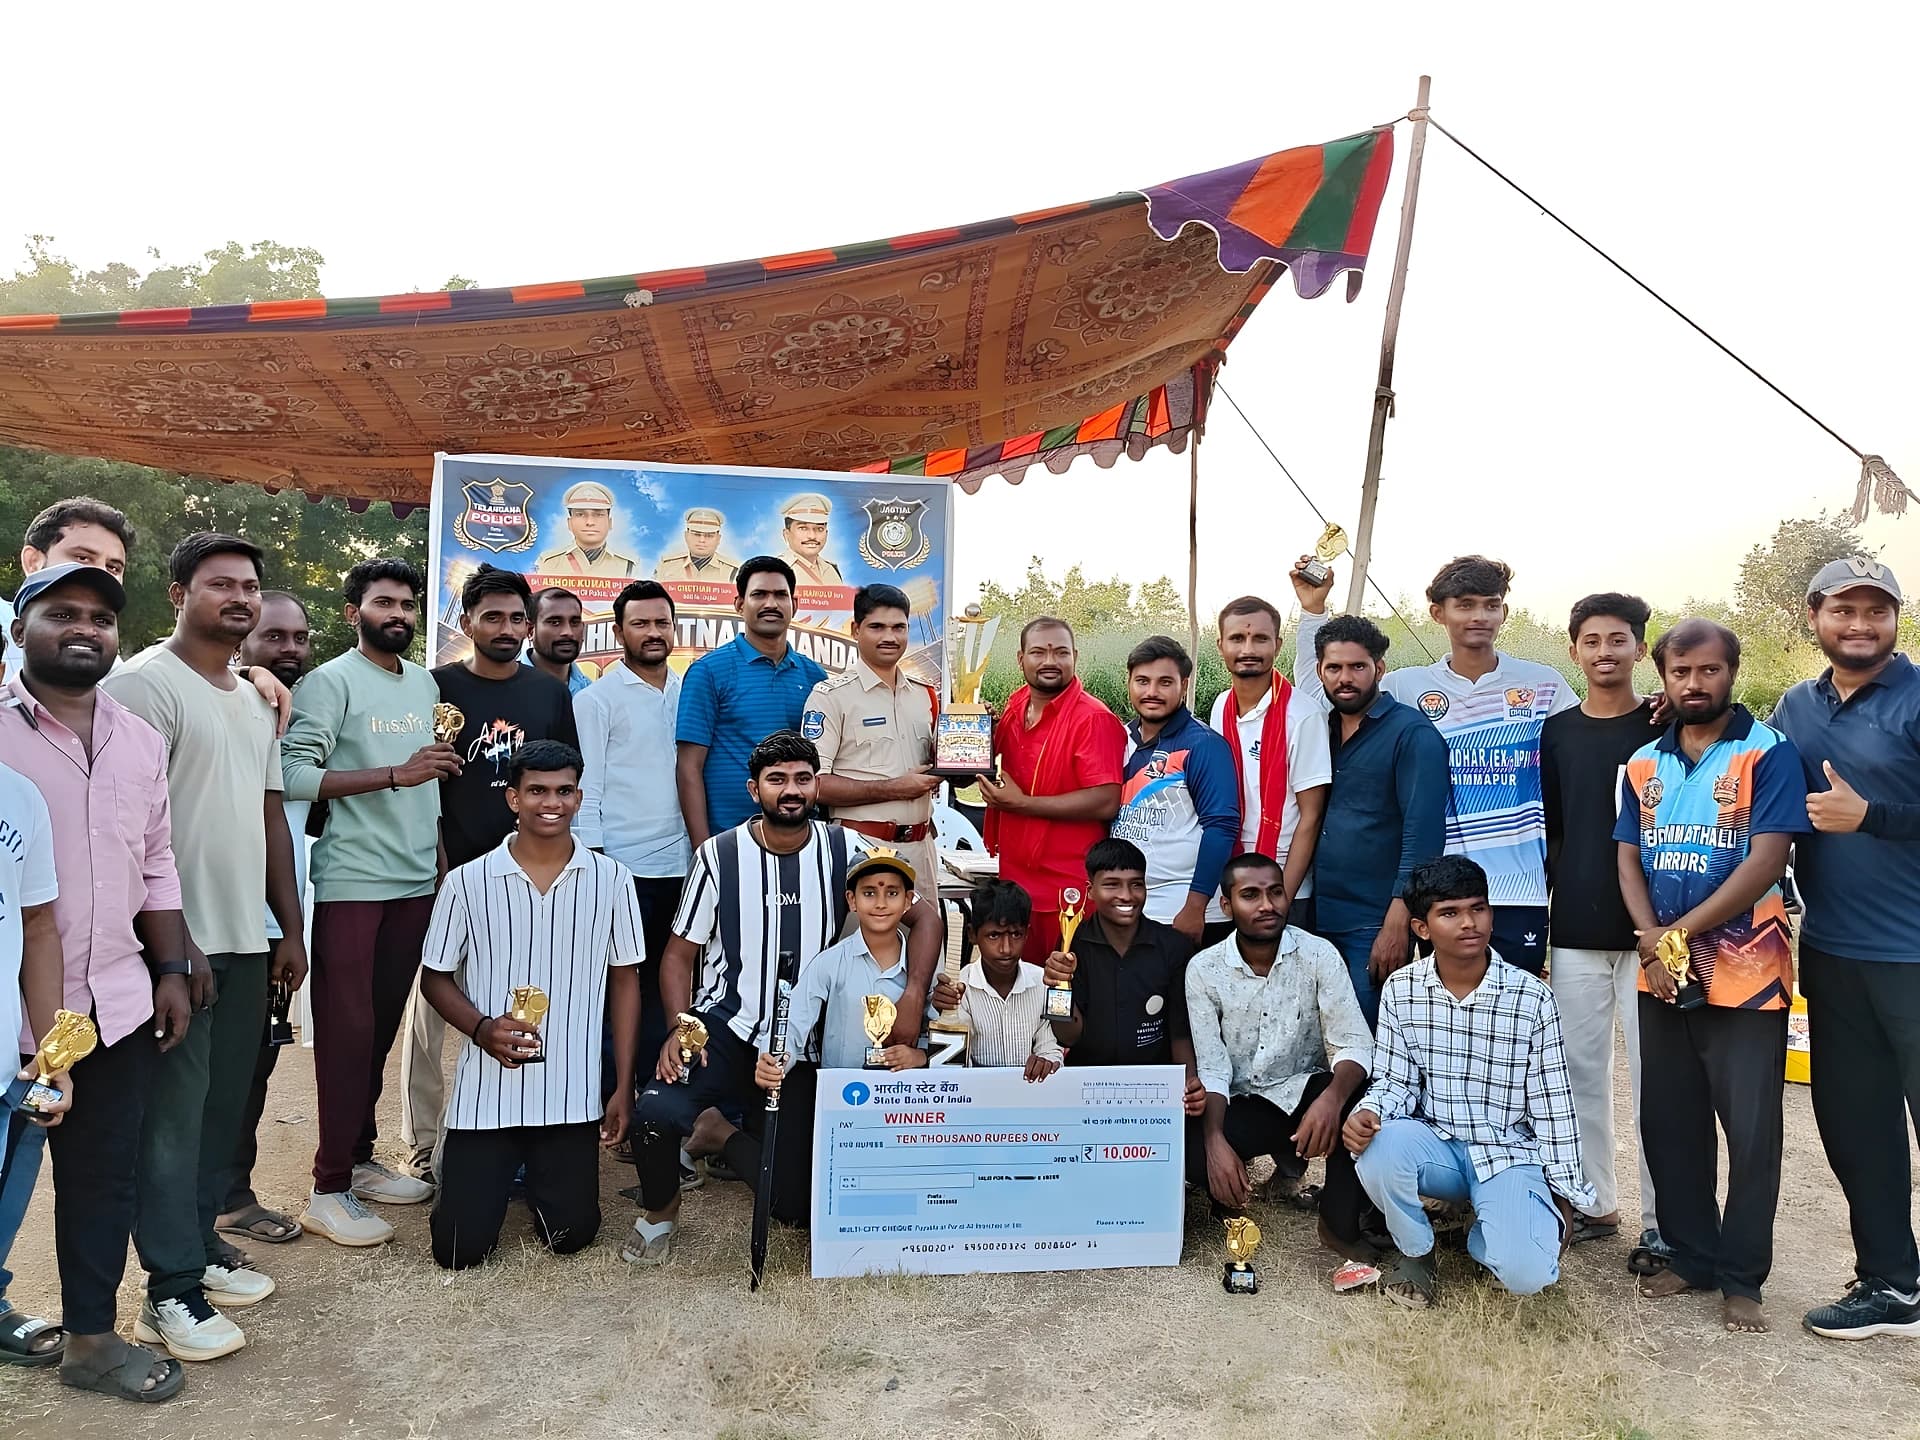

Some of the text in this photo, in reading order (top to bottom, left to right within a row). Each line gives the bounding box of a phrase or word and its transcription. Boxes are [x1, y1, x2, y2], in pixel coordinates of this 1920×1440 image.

[472, 512, 522, 525] POLICE
[874, 1081, 912, 1094] भारतीय
[915, 1081, 936, 1094] स्टेट
[874, 1094, 973, 1105] State Bank Of India
[884, 1111, 946, 1125] WINNER
[896, 1134, 918, 1144] TEN
[921, 1133, 982, 1144] THOUSAND
[984, 1132, 1028, 1143] RUPEES
[1031, 1132, 1060, 1142] ONLY
[1103, 1146, 1157, 1160] 10,000/-
